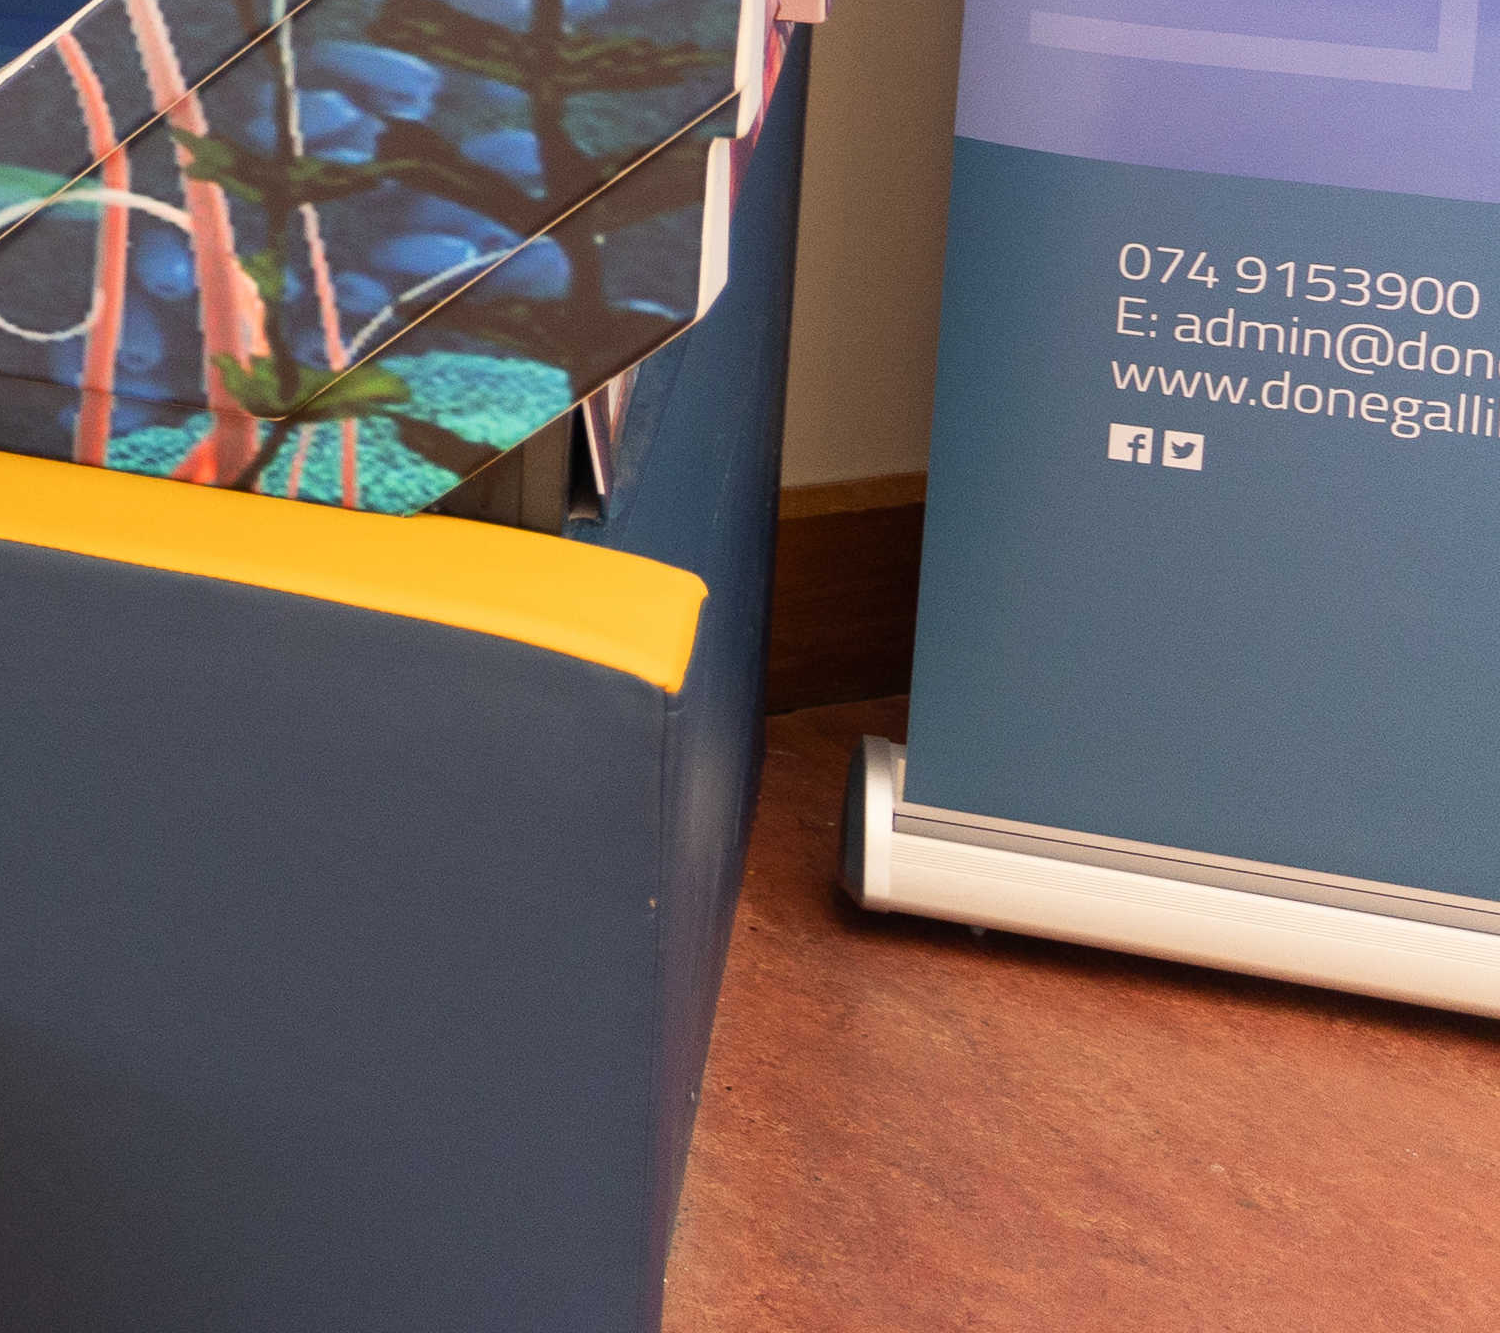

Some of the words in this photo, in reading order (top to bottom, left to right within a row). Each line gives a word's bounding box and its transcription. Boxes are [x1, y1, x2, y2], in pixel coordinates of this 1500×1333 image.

[1118, 242, 1220, 289] 074
[1235, 256, 1480, 320] 9153900
[1116, 295, 1159, 338] E:
[1173, 307, 1500, 380] admin@don
[1110, 360, 1500, 439] www.donegalli
